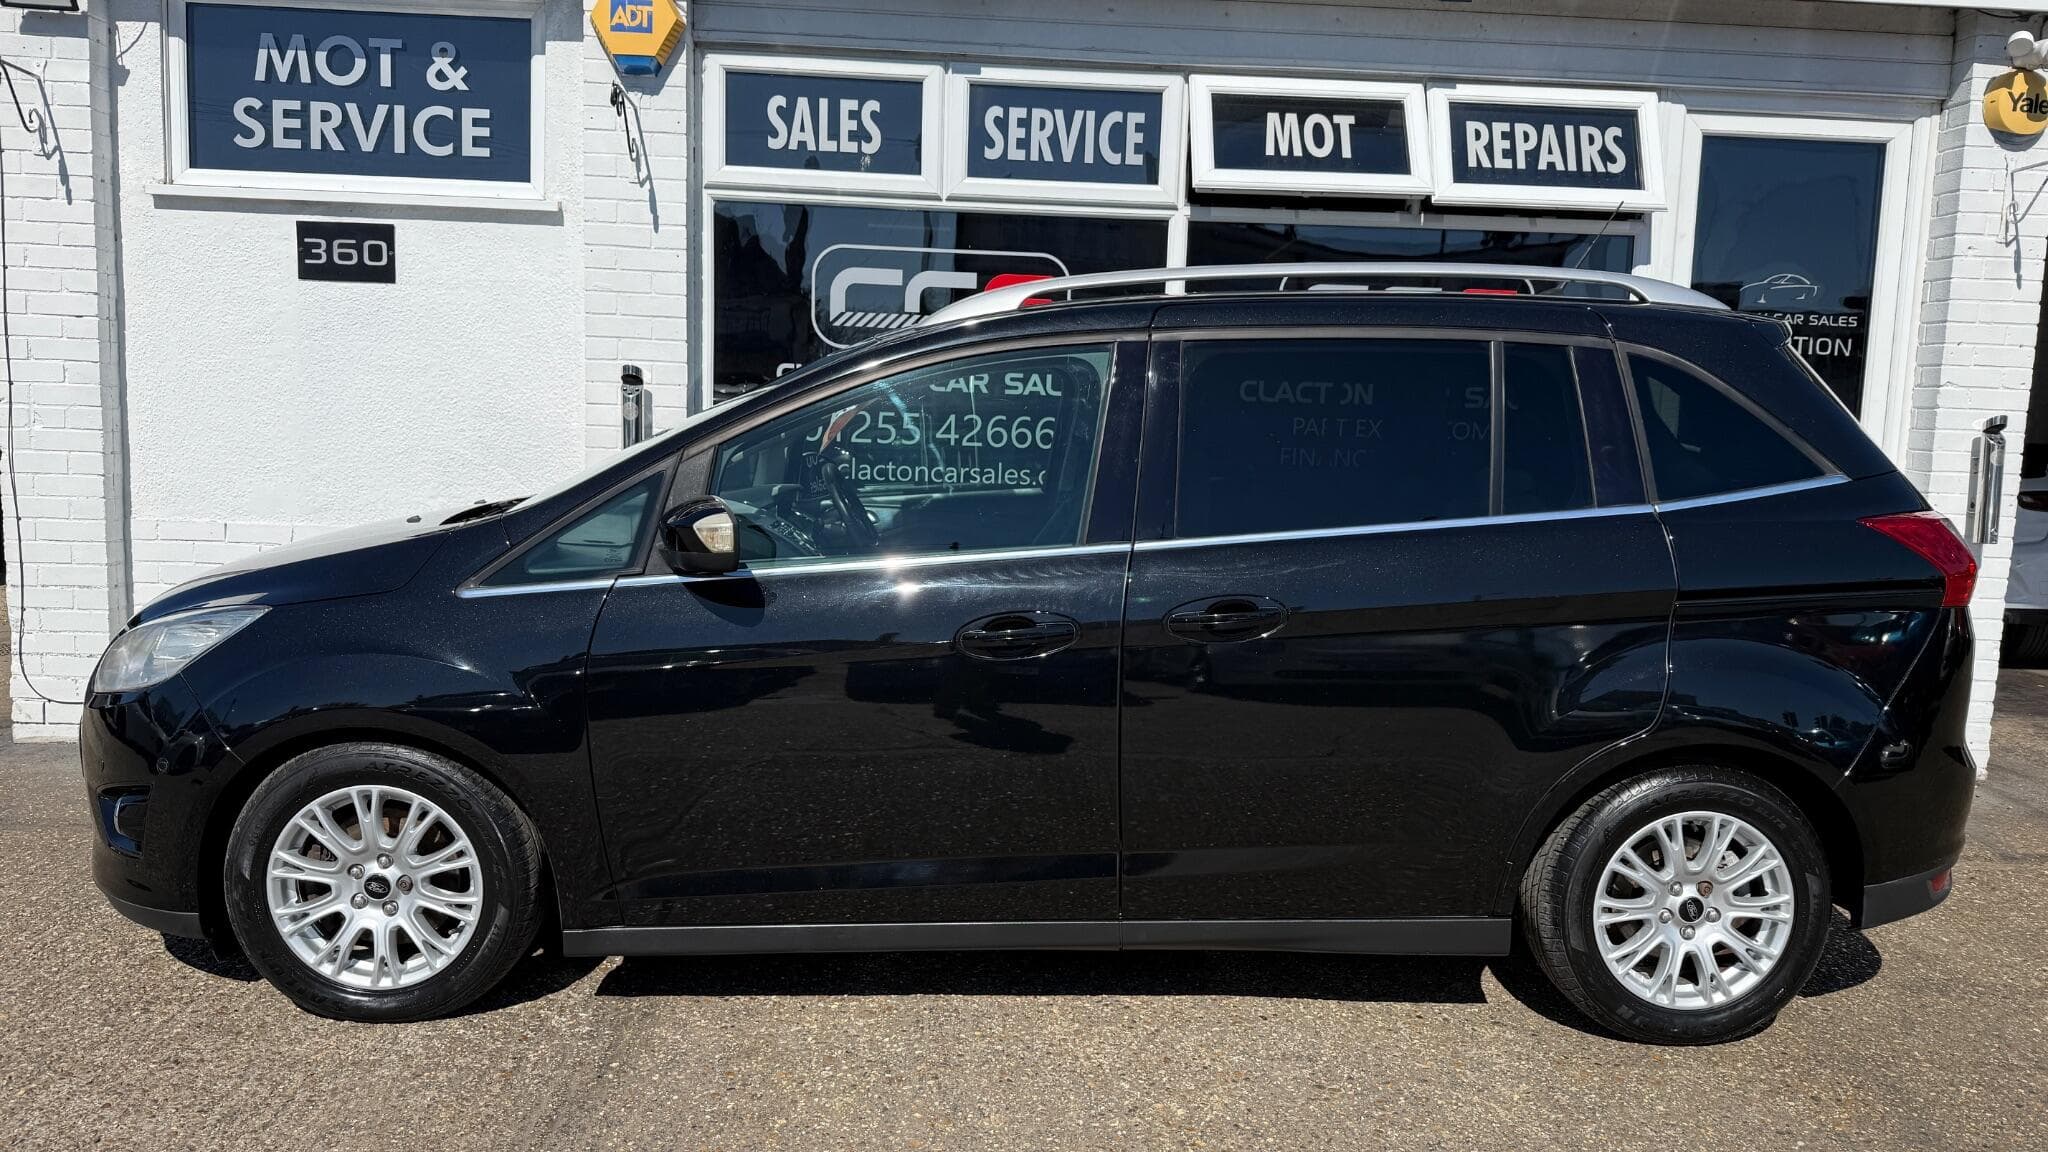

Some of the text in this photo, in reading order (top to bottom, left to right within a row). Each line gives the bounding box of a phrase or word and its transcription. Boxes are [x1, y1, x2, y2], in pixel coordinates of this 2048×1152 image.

[610, 5, 653, 28] ADT
[254, 32, 470, 91] MOT &
[233, 97, 491, 158] SERVICE
[766, 95, 882, 155] SALES
[2007, 92, 2048, 114] Yale
[984, 105, 1146, 166] SERVICE
[1265, 112, 1356, 159] MOT
[1465, 120, 1626, 174] REPAIRS
[303, 237, 388, 266] 360
[1774, 313, 1804, 325] AR
[1808, 315, 1858, 327] SALES
